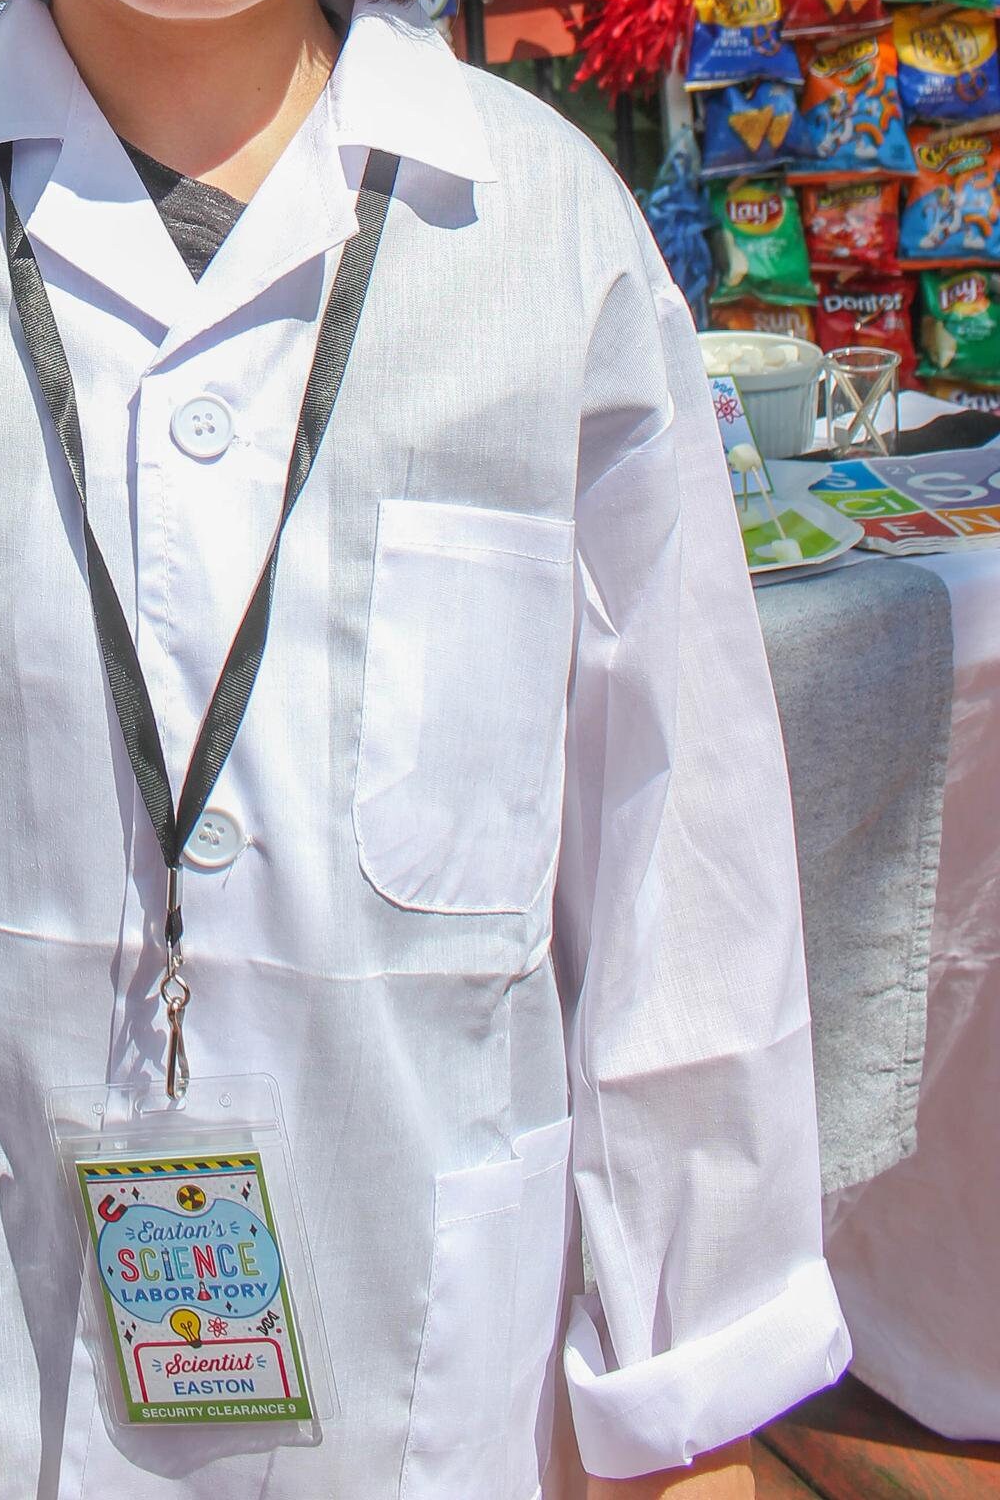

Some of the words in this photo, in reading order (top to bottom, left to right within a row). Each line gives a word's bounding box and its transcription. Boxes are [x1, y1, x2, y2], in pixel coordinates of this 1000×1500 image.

[137, 1219, 227, 1243] Easton's
[117, 1242, 261, 1282] SCIENCE
[164, 1352, 255, 1378] Scientist
[173, 1378, 256, 1396] EASTON
[142, 1406, 204, 1419] SECURITY
[206, 1403, 286, 1417] CLEARANCE
[288, 1403, 297, 1414] 9
